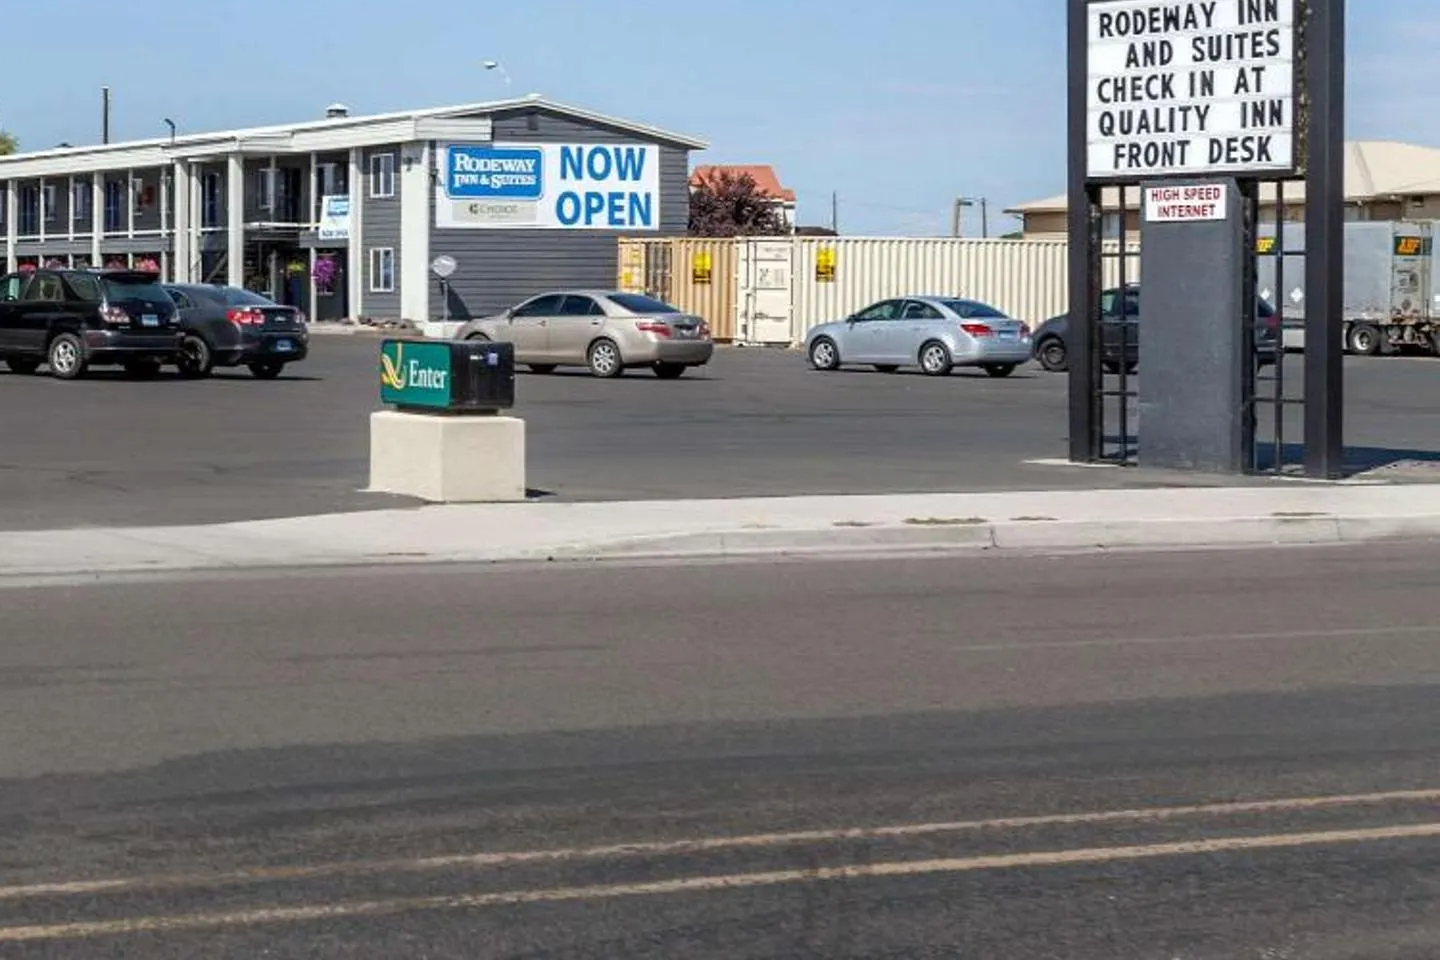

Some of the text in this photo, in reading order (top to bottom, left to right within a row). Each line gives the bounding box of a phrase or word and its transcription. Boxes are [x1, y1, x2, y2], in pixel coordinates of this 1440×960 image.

[1099, 1, 1216, 38] RODEWAY
[1125, 29, 1280, 68] AND SUITES
[1097, 66, 1265, 103] CHECK IN AT
[1099, 99, 1283, 136] QUALITY INN
[454, 153, 536, 172] RODEWAY
[560, 145, 646, 182] NOW
[1114, 135, 1272, 169] FRONT DESK
[454, 174, 478, 188] INN
[1151, 187, 1221, 201] HIGH SPEED
[556, 191, 651, 226] OPEN
[1157, 204, 1216, 218] INTERNET
[409, 360, 448, 388] Enter
